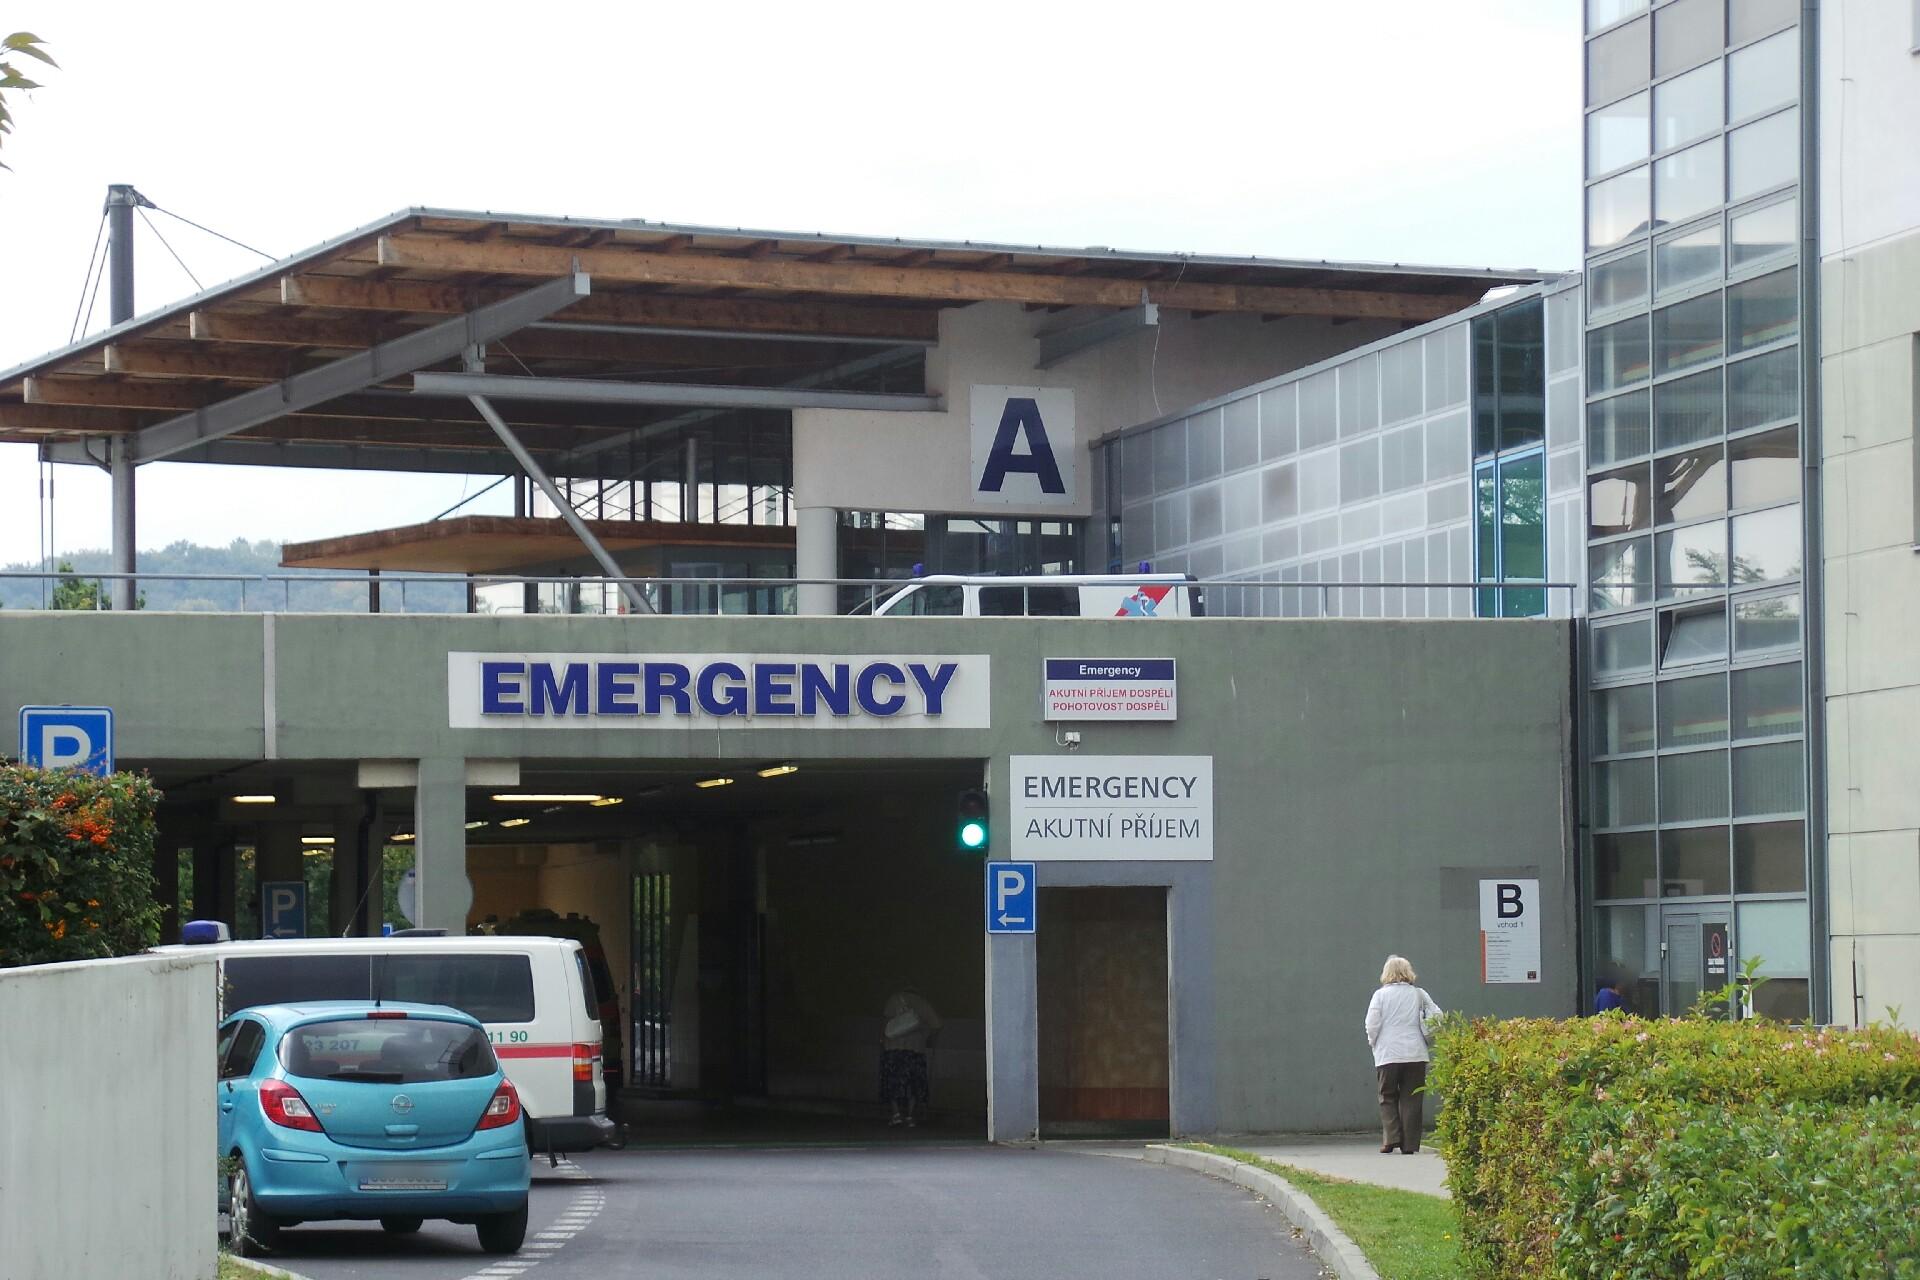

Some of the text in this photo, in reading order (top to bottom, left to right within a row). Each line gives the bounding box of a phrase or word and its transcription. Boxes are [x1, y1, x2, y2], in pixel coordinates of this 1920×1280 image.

[978, 398, 1066, 494] A
[1079, 665, 1141, 677] Emergency
[480, 661, 959, 716] EMERGENCY
[1049, 687, 1173, 698] AKUTNÍ PŘÍJEM DOSPĚLÍ
[1053, 700, 1169, 711] POHOTOVOST DOSPĚLÍ
[42, 725, 92, 769] P
[1024, 776, 1197, 799] EMERGENCY
[1025, 813, 1200, 838] AKUTNÍ PŘÍJEM
[997, 870, 1025, 911] P
[1497, 884, 1524, 918] B
[272, 889, 296, 923] P
[329, 1039, 361, 1051] 207
[510, 1030, 528, 1043] 90
